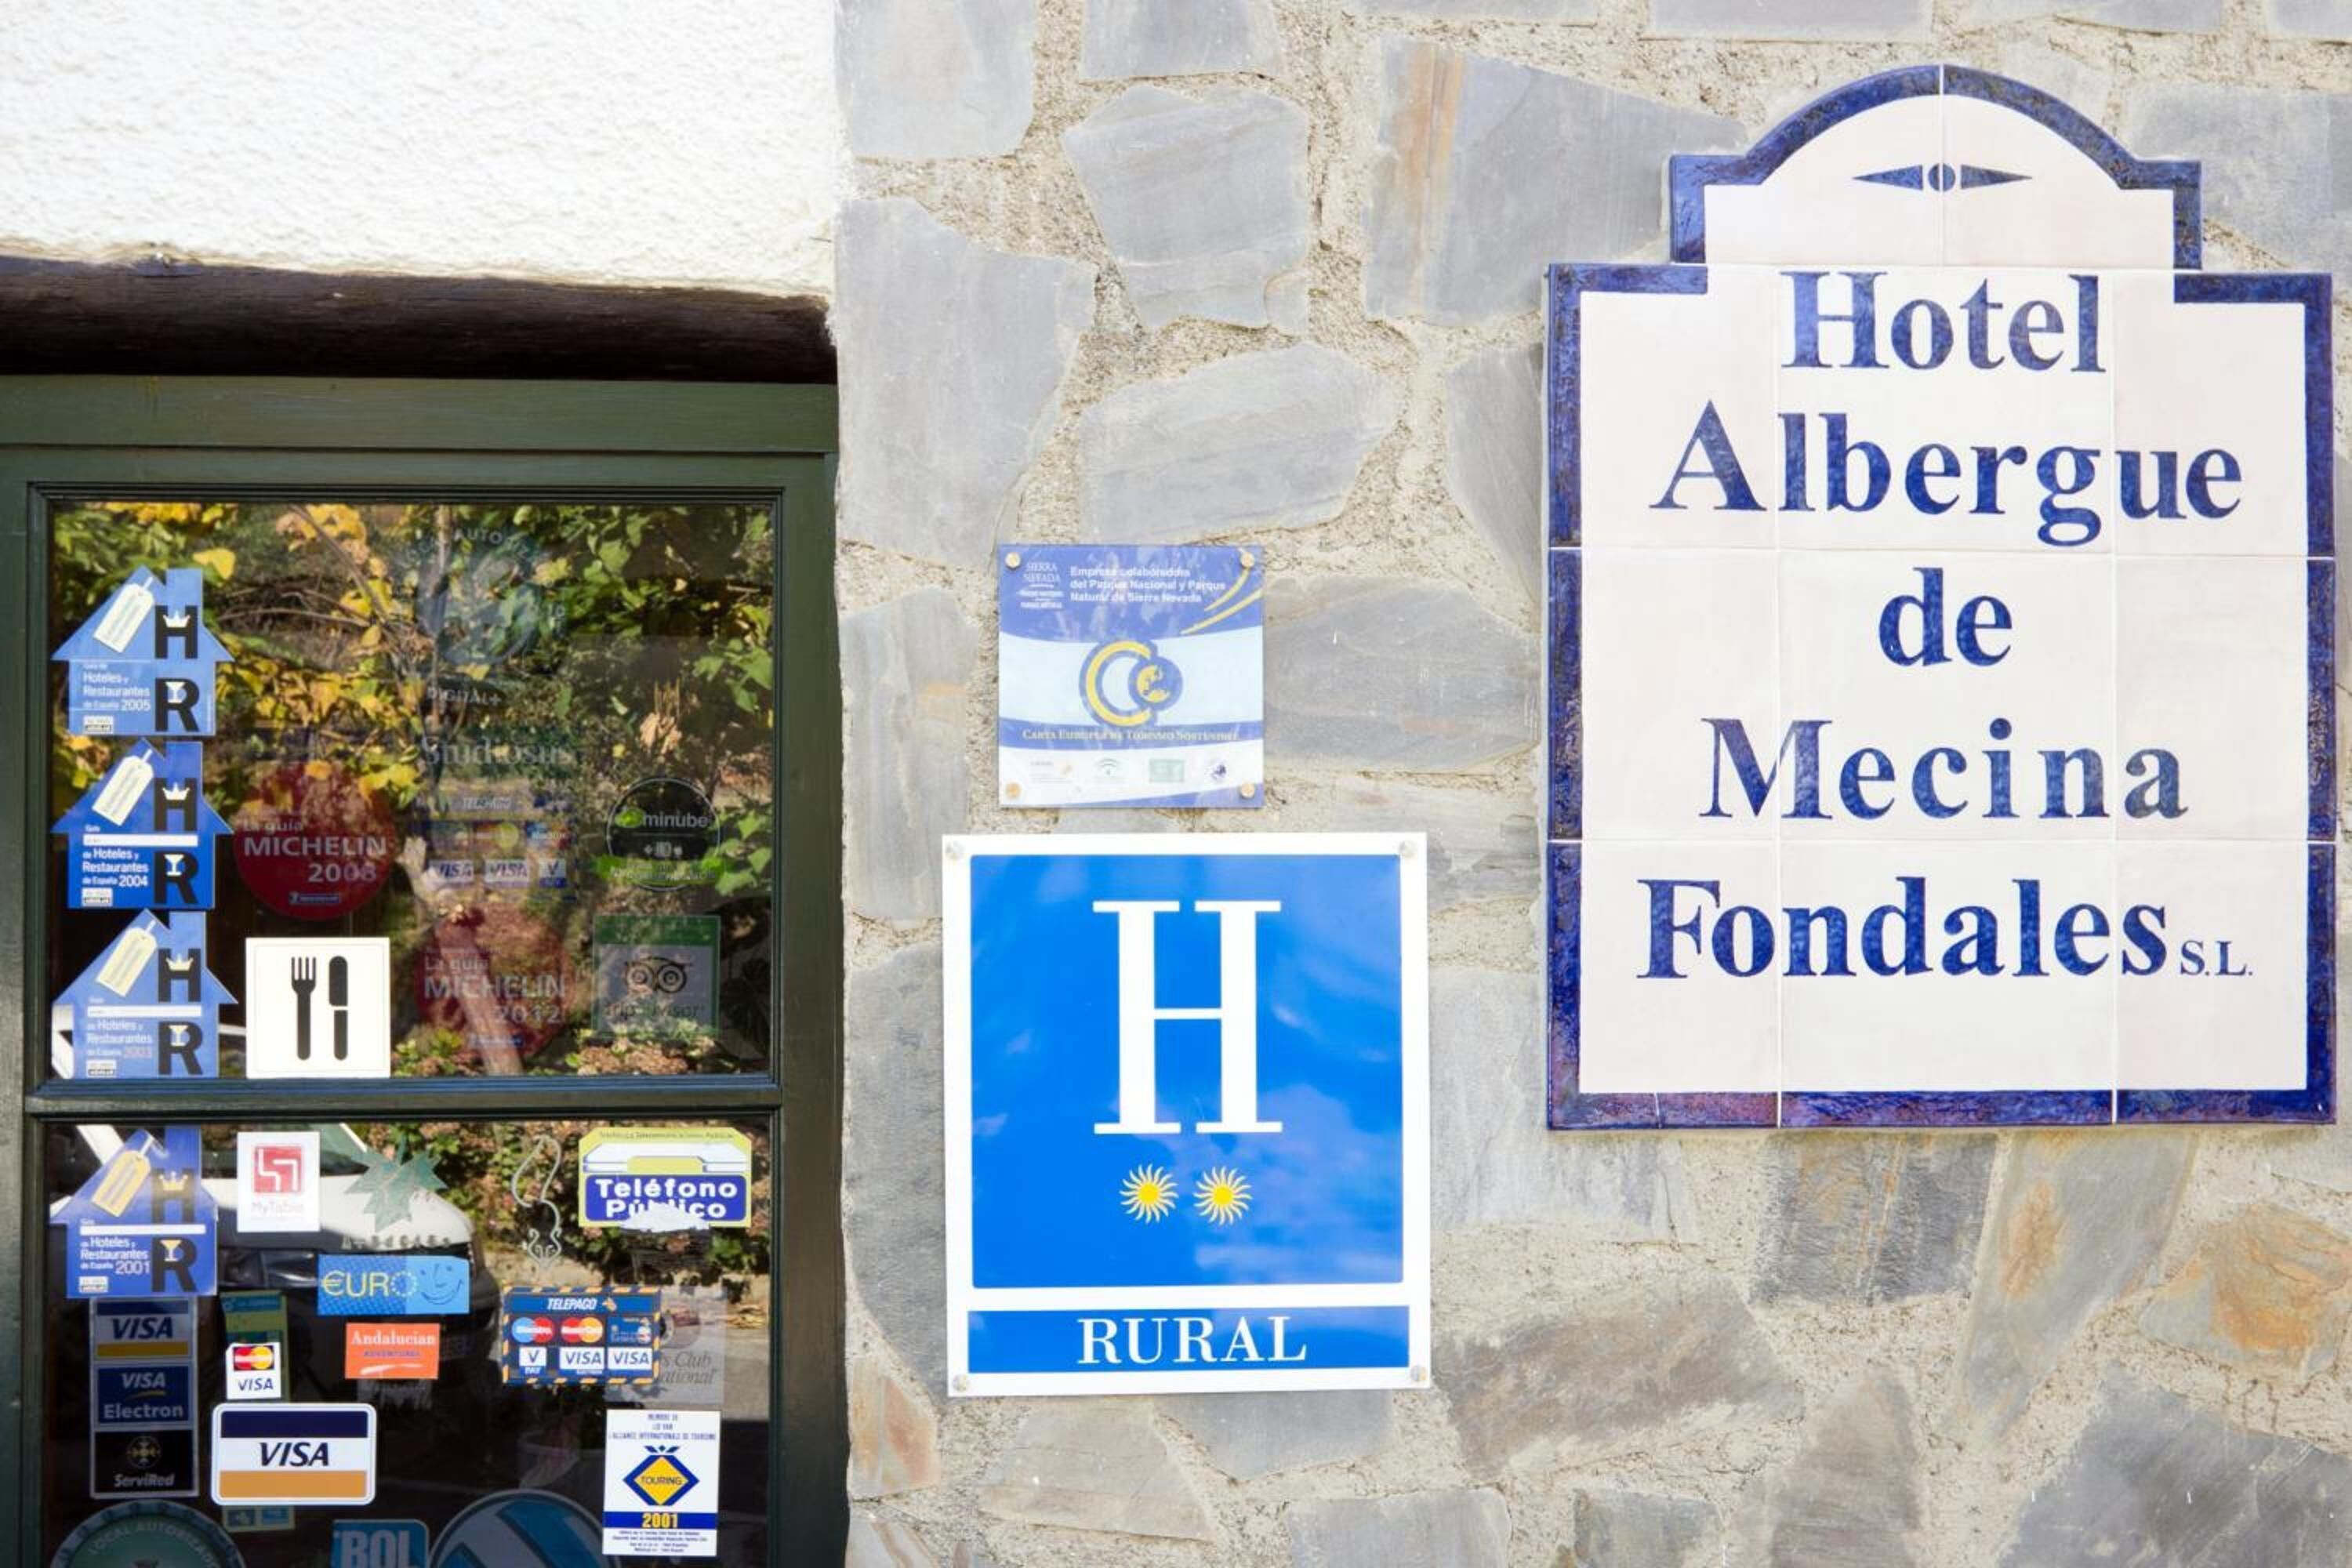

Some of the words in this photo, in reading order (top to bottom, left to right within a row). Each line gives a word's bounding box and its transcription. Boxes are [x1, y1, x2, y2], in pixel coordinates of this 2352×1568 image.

[1780, 270, 2106, 373] Hotel
[1648, 398, 2242, 547] Albergue
[1878, 566, 2013, 667] de
[83, 686, 150, 697] Restaurantes
[1698, 717, 2189, 819] Mecina
[643, 811, 709, 828] minube
[93, 848, 132, 859] Hoteles
[244, 836, 388, 857] MICHELIN
[82, 862, 149, 873] Restaurantes
[307, 863, 377, 883] 2008
[118, 876, 148, 887] 2004
[1636, 876, 2168, 979] Fondales
[2180, 939, 2254, 976] S.L.
[425, 975, 565, 999] MICHELIN
[1092, 900, 1283, 1134] H
[595, 1178, 738, 1199] Teléfono
[90, 1237, 130, 1248] Hoteles
[81, 1250, 149, 1260] Restaurantes
[115, 1261, 151, 1274] 2001
[546, 1298, 598, 1310] TELEPAGO
[112, 1317, 174, 1340] VISA
[351, 1329, 435, 1345] Andalucian
[1076, 1316, 1308, 1365] RURAL
[565, 1351, 602, 1365] VISA
[614, 1351, 650, 1365] VISA
[122, 1373, 166, 1388] VISA
[238, 1378, 274, 1392] VISA
[103, 1403, 183, 1419] Electron
[260, 1442, 329, 1467] VISA
[114, 1472, 175, 1487] ServiRed
[641, 1476, 682, 1486] TOURING
[641, 1512, 678, 1529] 2001
